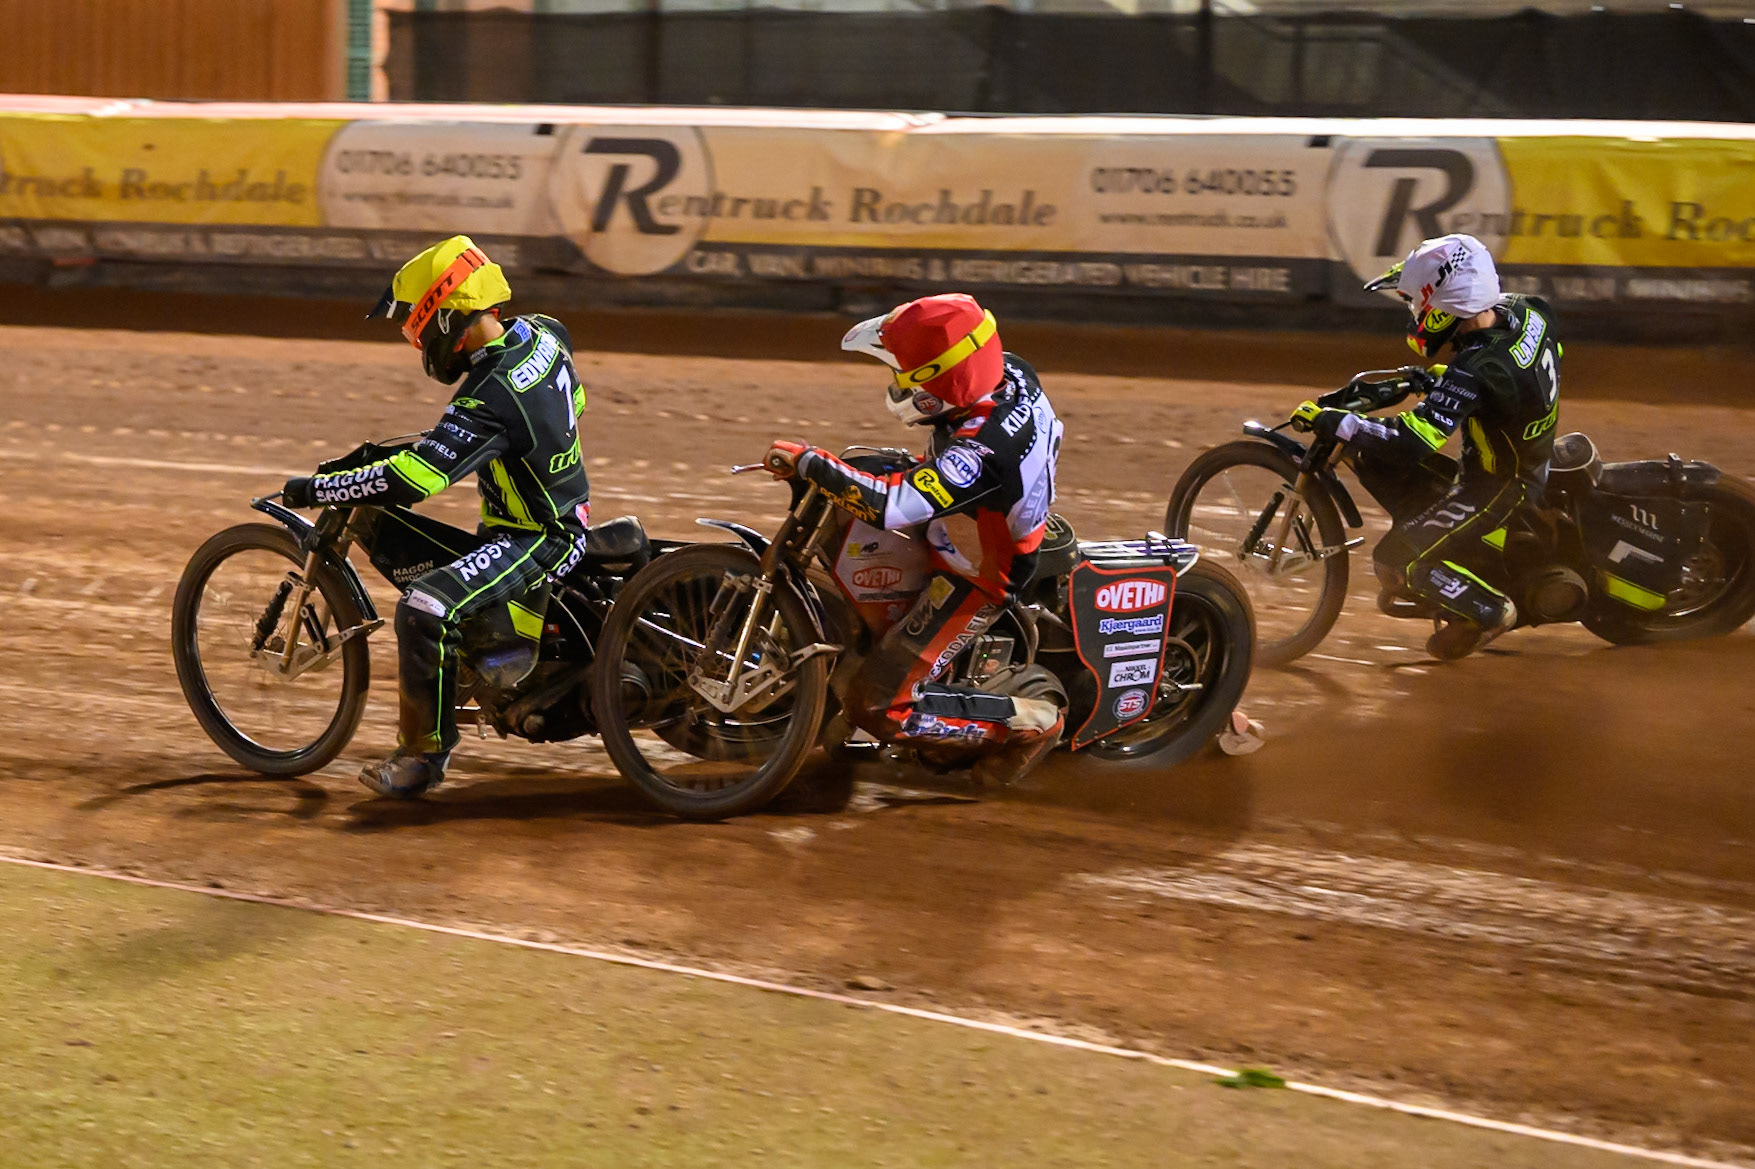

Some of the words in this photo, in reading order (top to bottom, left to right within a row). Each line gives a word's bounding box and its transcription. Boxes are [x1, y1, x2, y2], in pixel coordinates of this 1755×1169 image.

[582, 137, 832, 235] Rentruck
[849, 186, 1057, 226] Rochdale
[1091, 167, 1176, 194] 01706
[1183, 169, 1297, 197] 640055
[411, 272, 454, 334] SCOTT
[314, 463, 386, 489] HAGON
[315, 477, 389, 503] SHOCKS
[393, 560, 434, 577] HAGON
[1097, 581, 1165, 609] OVETHI
[1101, 615, 1162, 633] Kjærgaard
